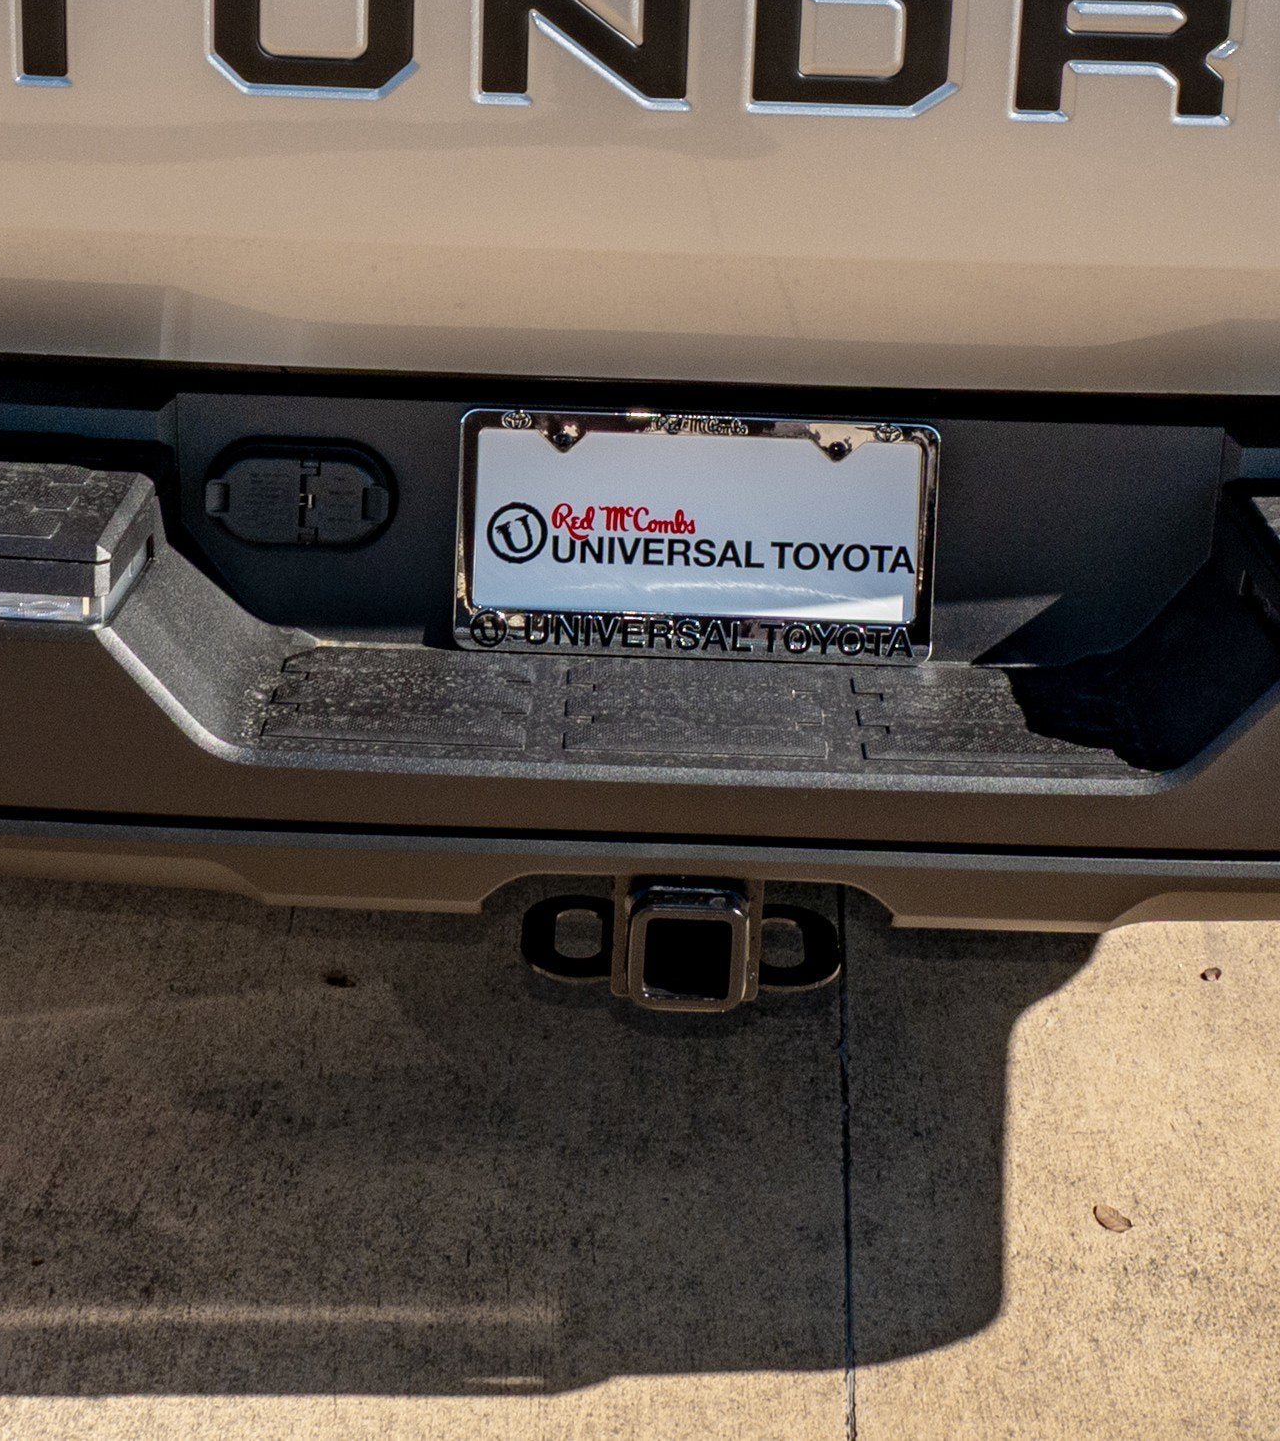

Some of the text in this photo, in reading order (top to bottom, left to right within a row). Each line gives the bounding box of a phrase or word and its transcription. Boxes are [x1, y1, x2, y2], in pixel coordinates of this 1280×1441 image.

[551, 503, 696, 541] Red McCombs
[551, 535, 915, 574] UNIVERSAL TOYOTA
[523, 612, 915, 658] UNIVERSAL TOYOTA
